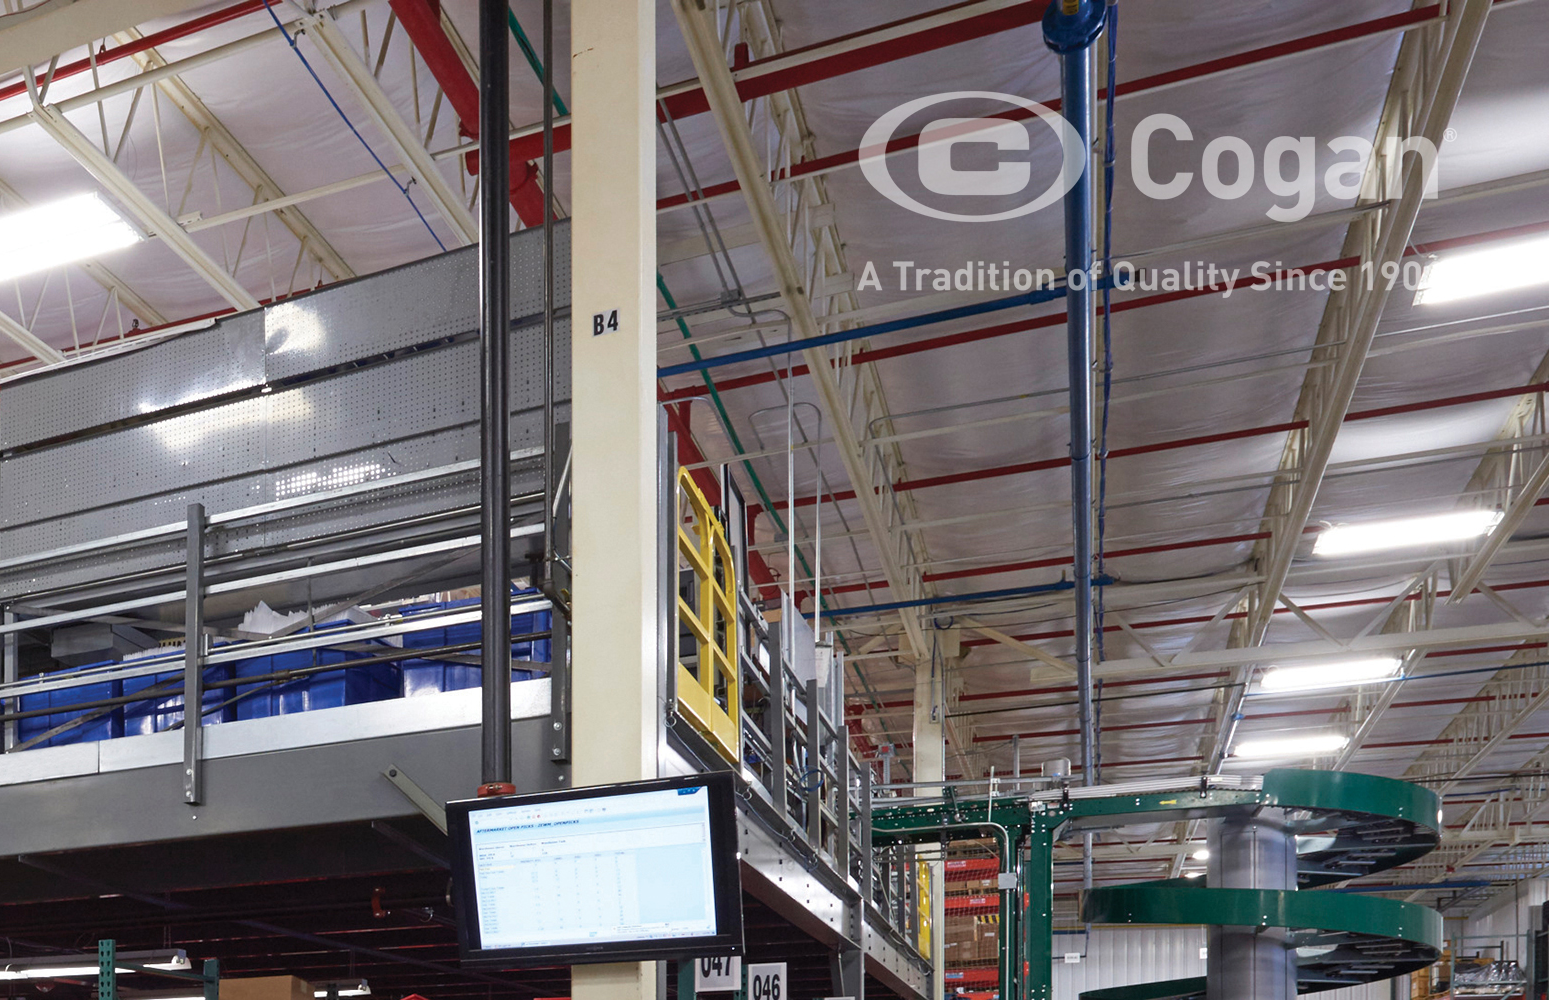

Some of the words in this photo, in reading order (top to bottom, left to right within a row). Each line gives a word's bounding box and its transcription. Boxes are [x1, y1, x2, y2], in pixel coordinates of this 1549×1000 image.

[593, 310, 618, 336] B4
[701, 957, 731, 978] 047
[753, 974, 781, 1000] 046
